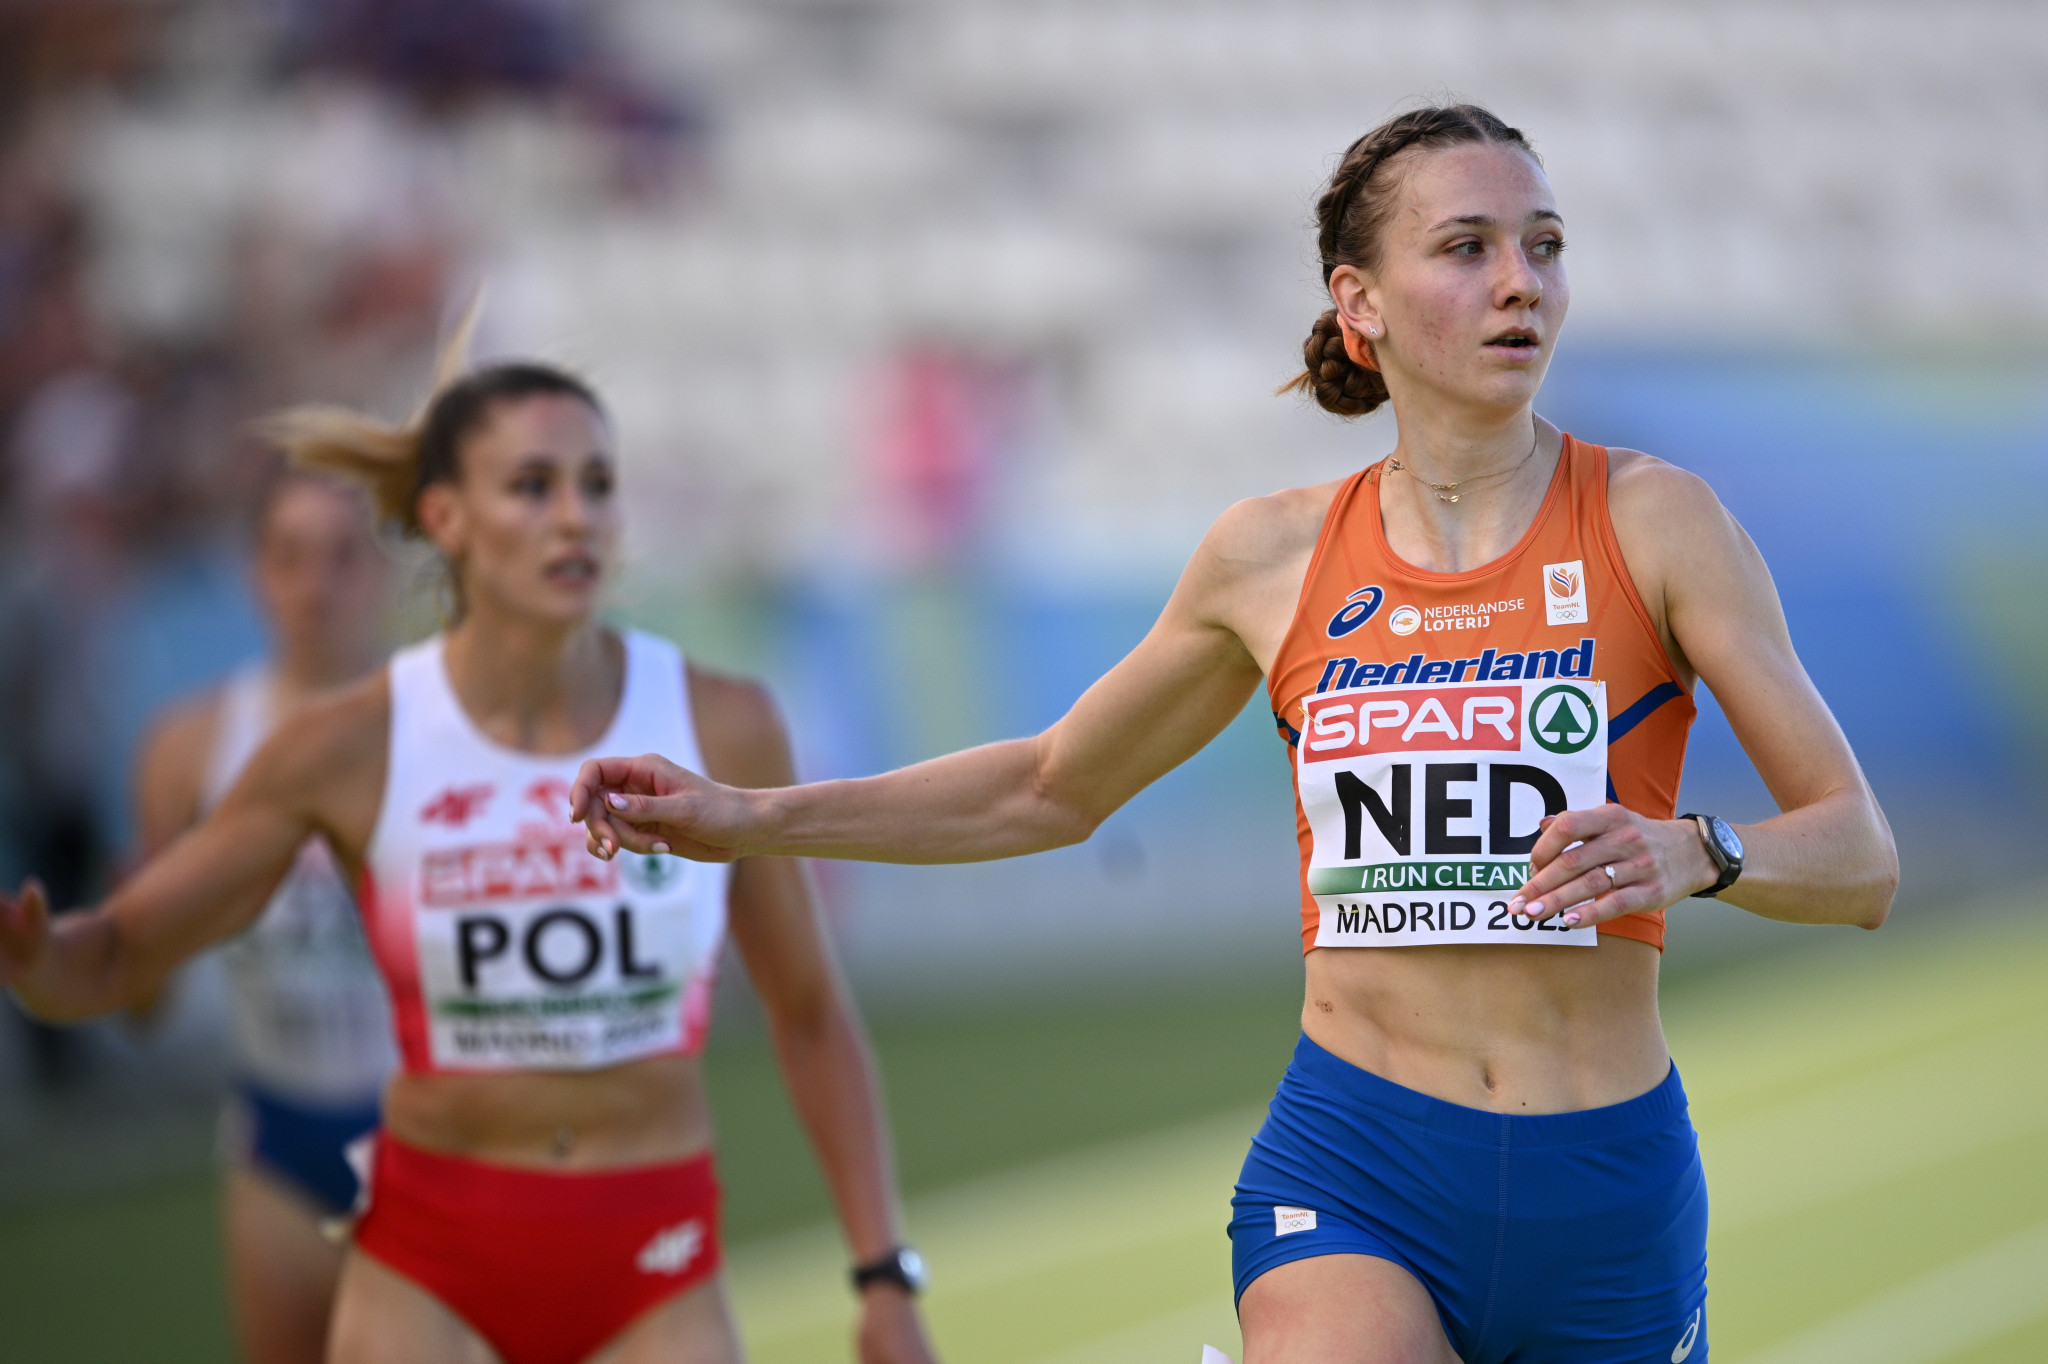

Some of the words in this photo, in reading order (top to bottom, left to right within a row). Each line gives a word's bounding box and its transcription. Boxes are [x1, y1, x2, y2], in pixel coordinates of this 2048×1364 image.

[1424, 598, 1525, 619] NEDERLANDSE
[1552, 602, 1581, 610] TeamNL
[1423, 615, 1491, 632] LOTERIJ
[1309, 696, 1516, 752] SPAR
[1334, 763, 1568, 860] NED
[1361, 869, 1369, 889] I
[1372, 866, 1427, 889] RUN
[1434, 865, 1528, 888] CLEAN
[1337, 901, 1476, 934] MADRID
[457, 904, 662, 988] POL
[1282, 1211, 1309, 1220] TeamNL
